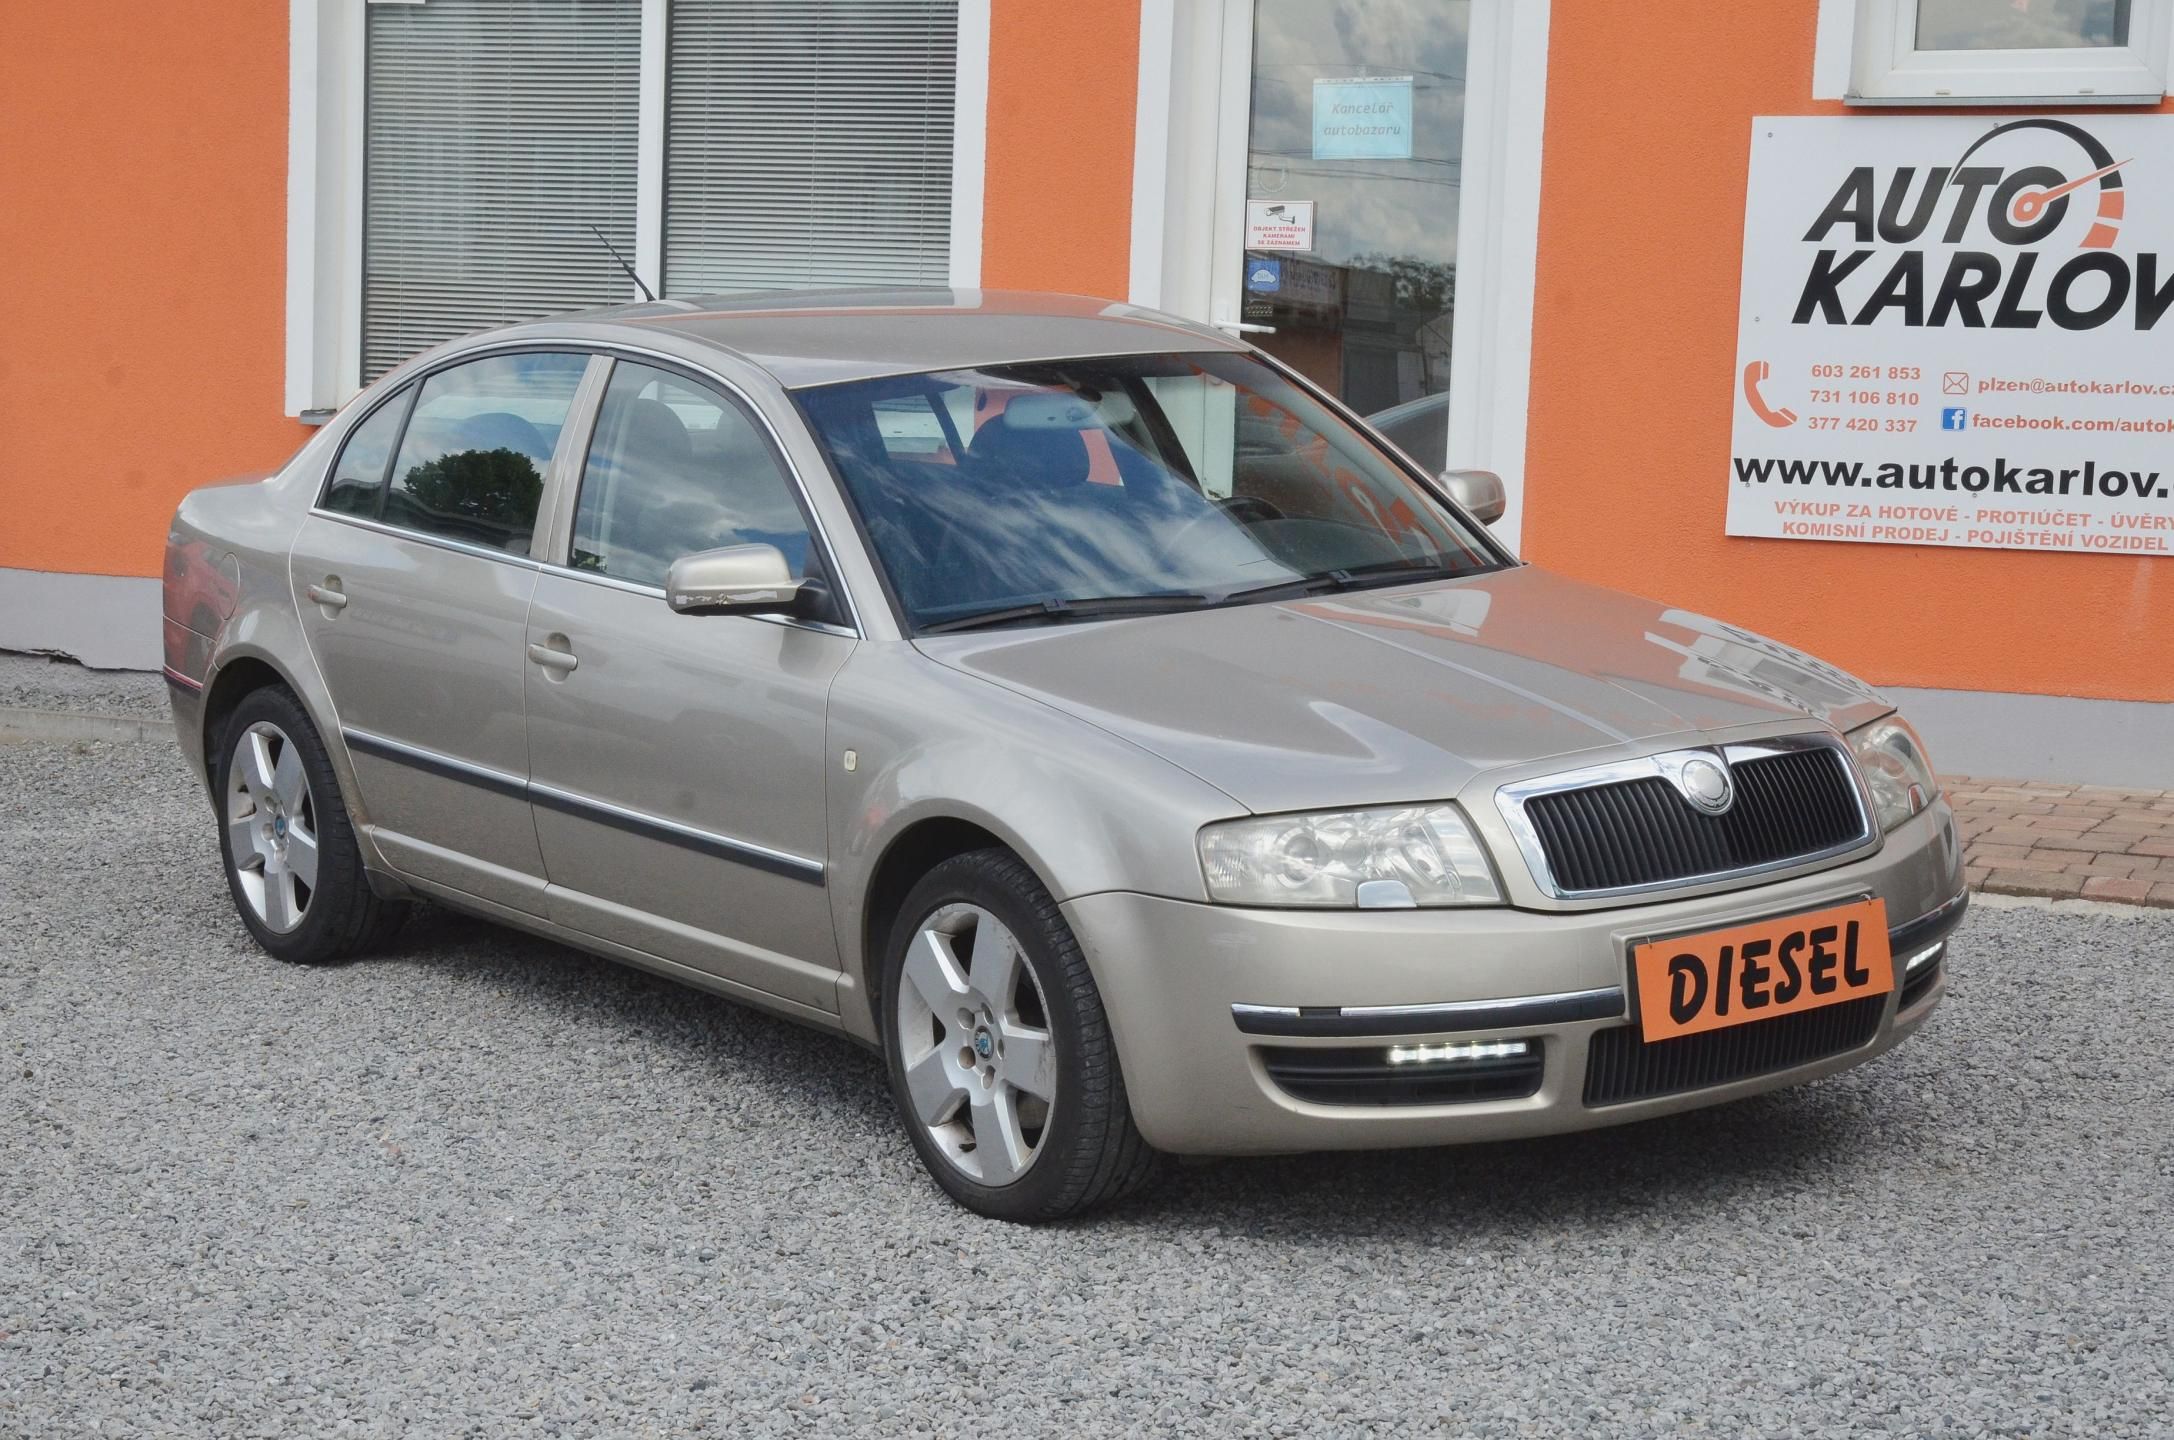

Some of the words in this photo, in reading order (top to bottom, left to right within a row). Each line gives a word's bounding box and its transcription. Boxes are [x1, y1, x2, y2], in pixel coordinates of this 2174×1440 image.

[1323, 124, 1401, 136] autobazaru
[1801, 166, 2071, 246] AUTO
[1811, 364, 1844, 378] 603
[1849, 365, 1881, 379] 261
[1888, 366, 1921, 380] 853
[1810, 389, 1841, 404] 731
[1848, 390, 1880, 405] 106
[1886, 391, 1919, 406] 810
[1978, 377, 2174, 396] plzen@autokarlov.c
[1808, 416, 1840, 431] 377
[1846, 417, 1879, 432] 420
[1884, 418, 1918, 433] 337
[1733, 457, 2174, 499] www.autokarlov.
[1774, 499, 1841, 517] VÝKUP
[1846, 504, 1872, 518] ZA
[1879, 505, 1958, 522] HOTOVÉ
[1976, 509, 2092, 527] PROTIÚČET
[1783, 521, 1865, 538] KOMISNÍ
[1872, 525, 1949, 542] PRODEJ
[1967, 528, 2073, 547] POJIŠTĚNÍ
[2081, 534, 2168, 550] VOZIDEL
[1668, 920, 1870, 1026] DIESEL
